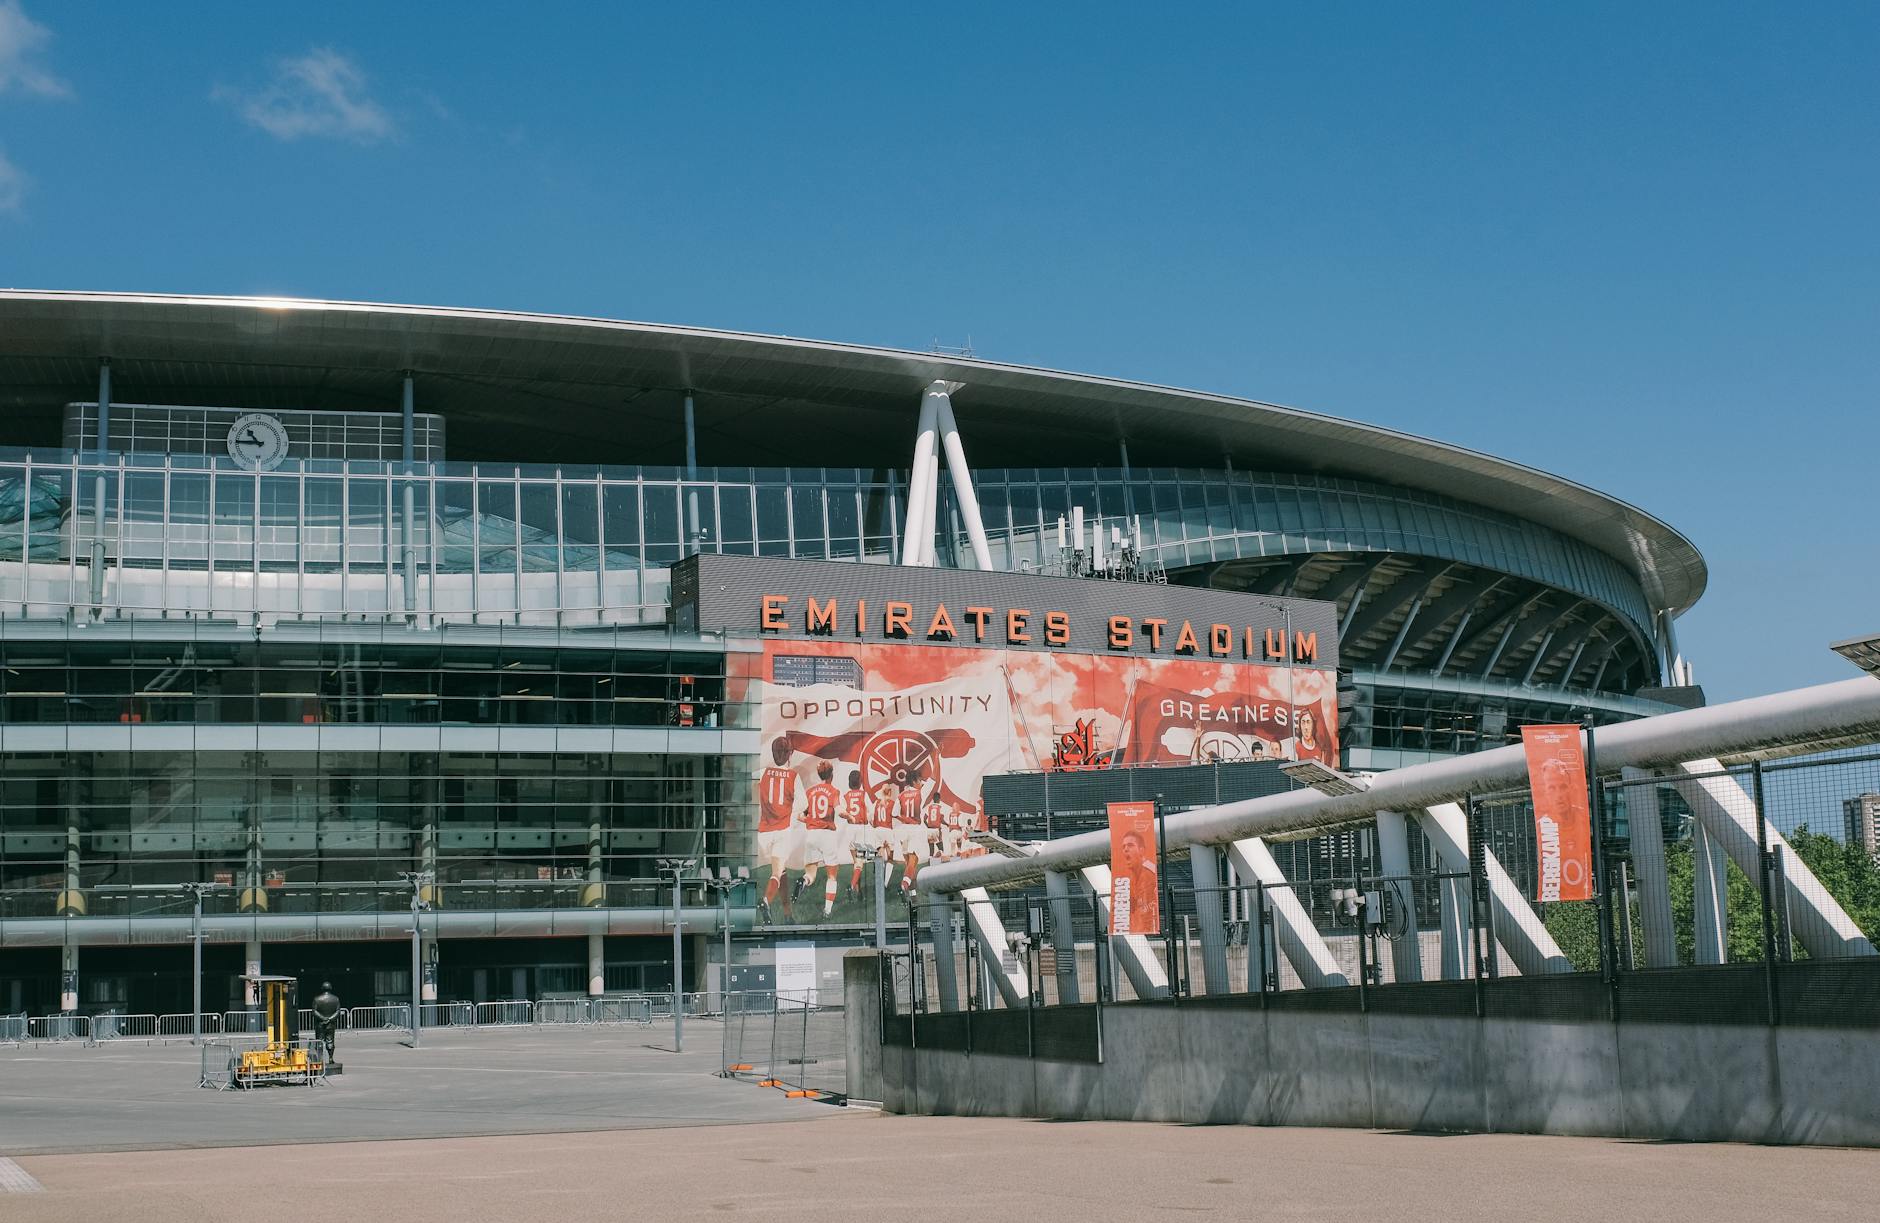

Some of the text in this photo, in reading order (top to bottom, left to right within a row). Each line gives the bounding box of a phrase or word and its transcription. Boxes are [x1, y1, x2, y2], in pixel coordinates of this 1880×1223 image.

[761, 595, 1318, 661] EMIRATES STADIUM
[780, 694, 992, 720] OPPORTUNITY
[1160, 699, 1300, 729] GREATNESS
[768, 778, 785, 805] 11
[811, 795, 829, 819] 19
[849, 797, 861, 816] 5
[878, 806, 887, 822] 10
[904, 798, 915, 818] 11
[1539, 815, 1561, 902] BERGKAMP
[1113, 876, 1131, 935] FABREGAS
